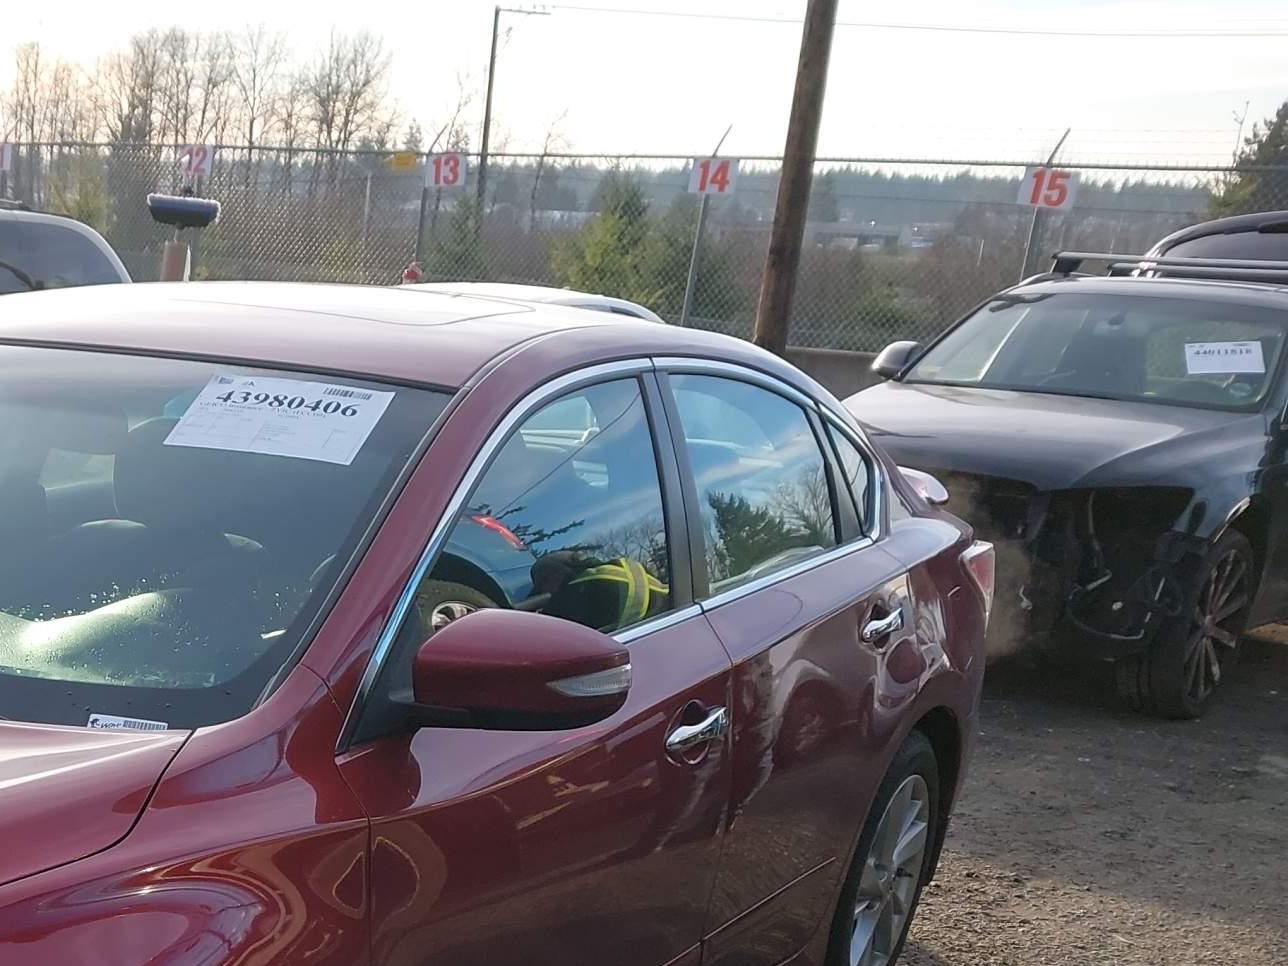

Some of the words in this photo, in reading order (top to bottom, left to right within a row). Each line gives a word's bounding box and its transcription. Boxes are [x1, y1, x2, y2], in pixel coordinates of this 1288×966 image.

[186, 147, 207, 175] 12
[432, 154, 459, 185] 13
[697, 160, 730, 193] 14
[1029, 168, 1071, 207] 15
[215, 389, 361, 418] 43980406
